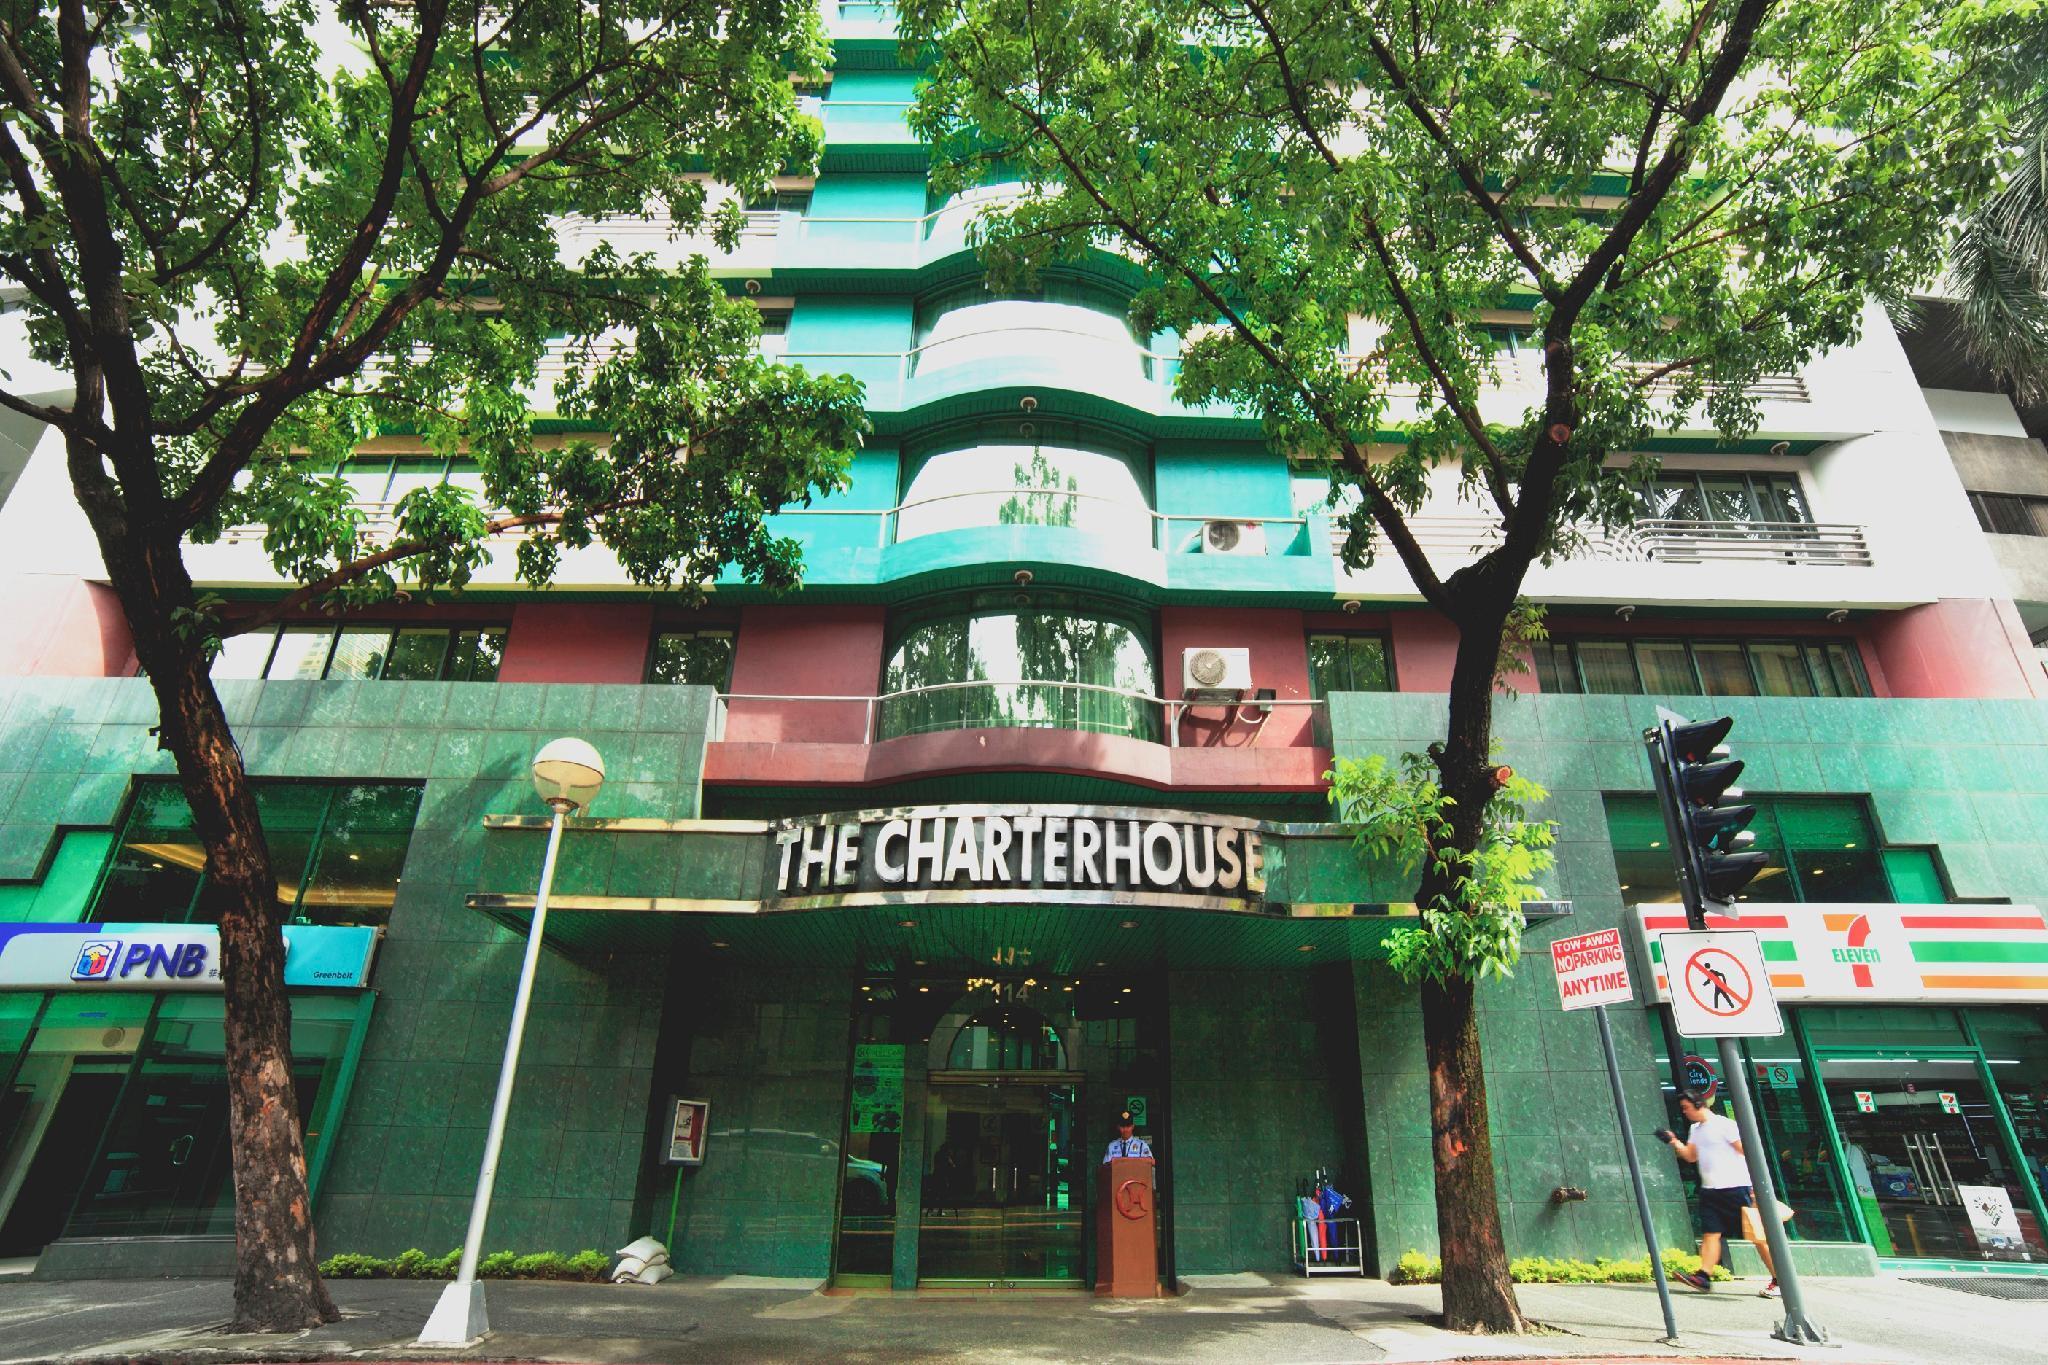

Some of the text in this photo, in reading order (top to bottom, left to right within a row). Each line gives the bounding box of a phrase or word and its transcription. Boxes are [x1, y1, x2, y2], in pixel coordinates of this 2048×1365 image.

[775, 816, 1266, 893] THE CHARTERHOUSE
[1554, 932, 1615, 953] TOW-AWAY
[119, 943, 208, 978] PNB
[1556, 945, 1622, 973] NO PARKING
[313, 971, 353, 979] Greenbelt
[1563, 971, 1627, 998] ANYTIME
